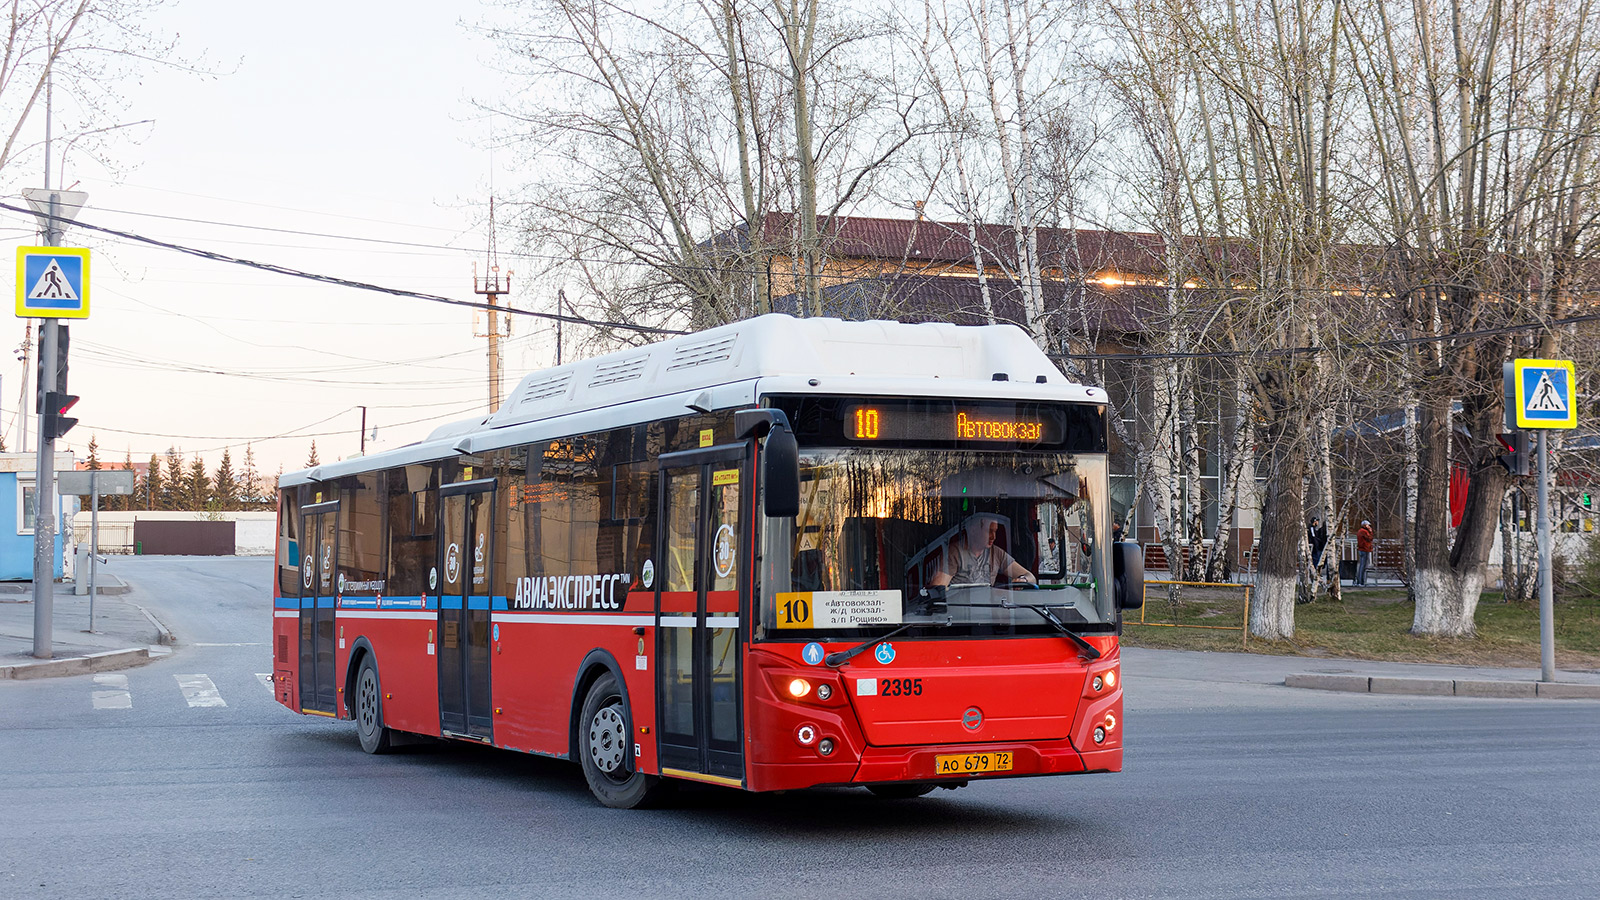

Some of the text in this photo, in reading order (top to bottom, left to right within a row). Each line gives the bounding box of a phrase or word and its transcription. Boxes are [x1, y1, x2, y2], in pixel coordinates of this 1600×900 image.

[855, 409, 879, 439] 10
[514, 573, 620, 609] АВИАЭКСПРЕСС
[783, 599, 809, 623] 10
[825, 599, 885, 607] «Автовокзал-
[881, 678, 922, 696] 2395
[965, 755, 989, 770] 679
[996, 753, 1009, 764] 72
